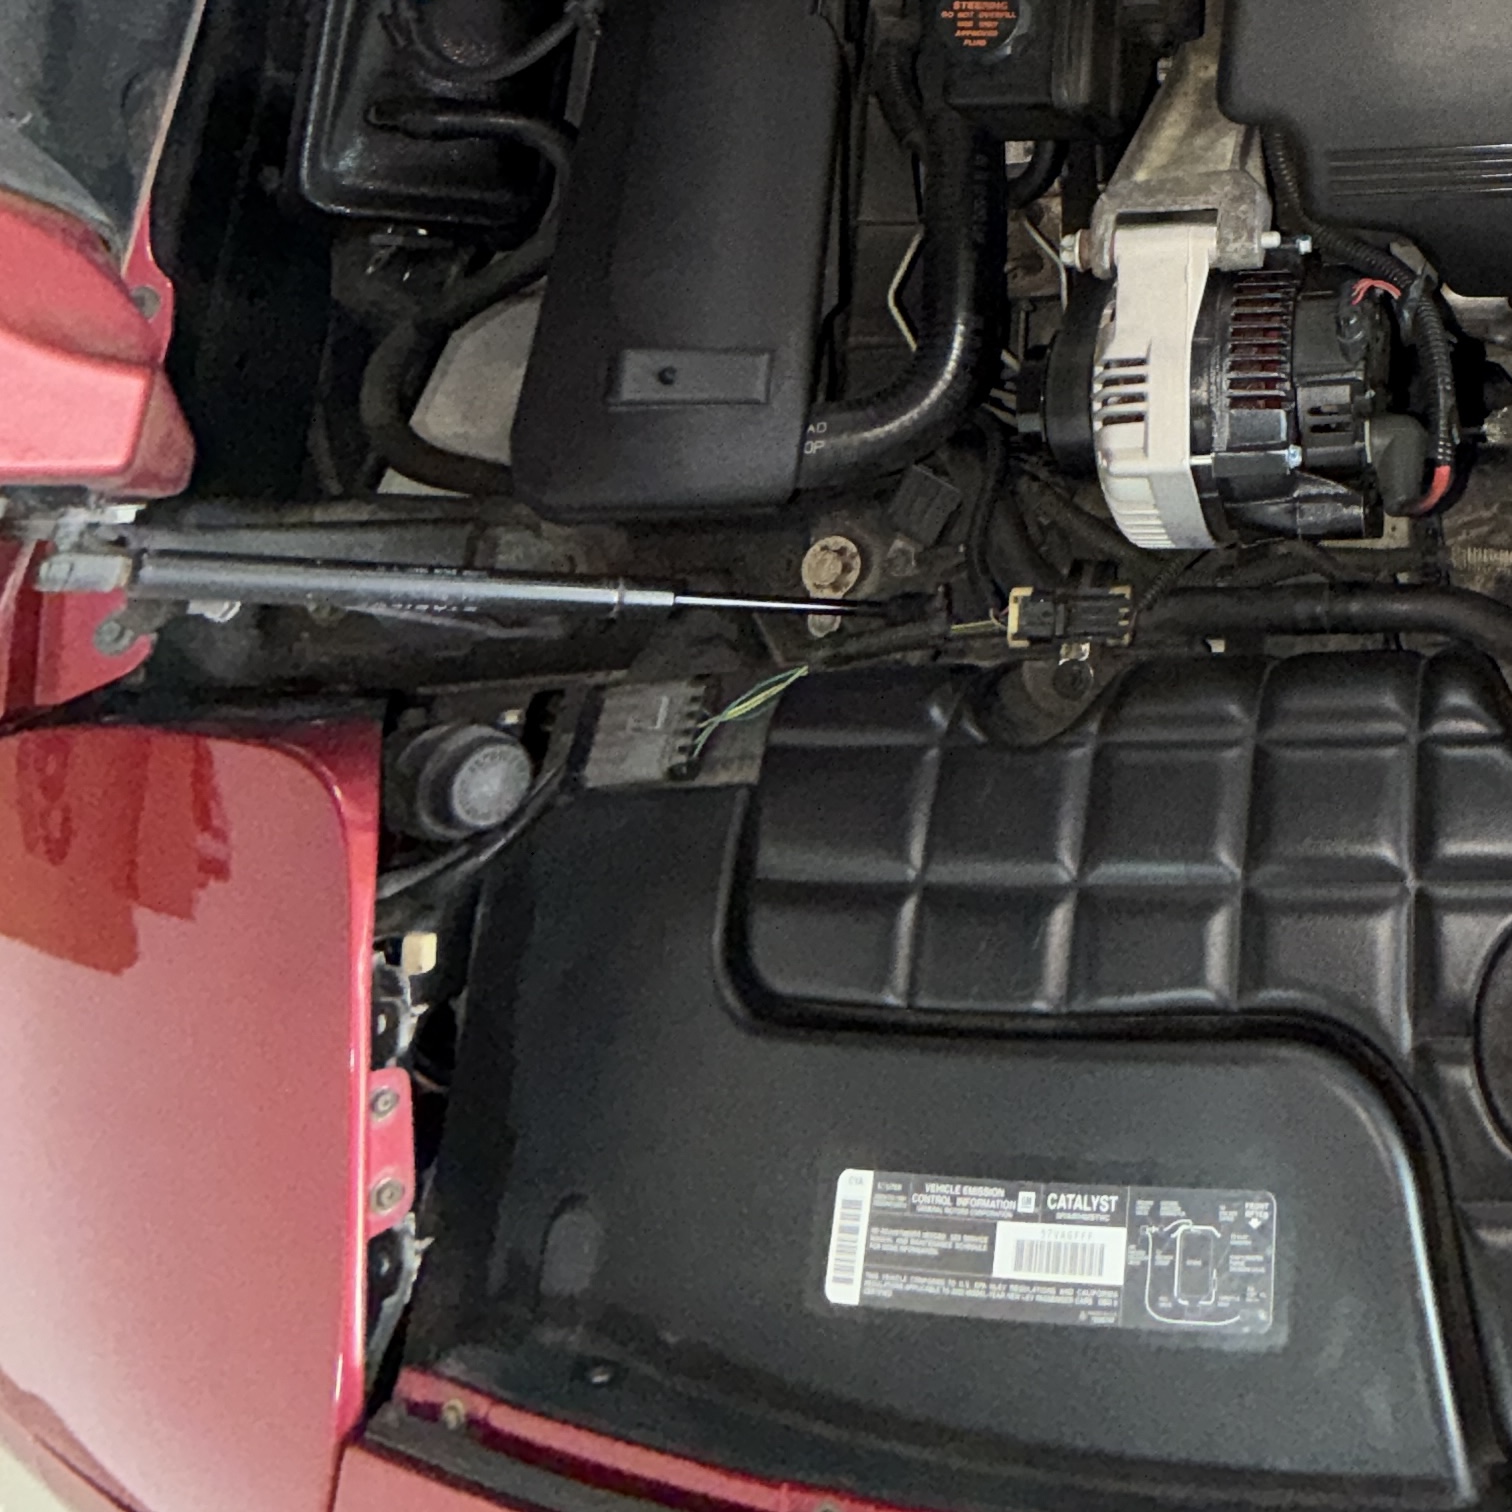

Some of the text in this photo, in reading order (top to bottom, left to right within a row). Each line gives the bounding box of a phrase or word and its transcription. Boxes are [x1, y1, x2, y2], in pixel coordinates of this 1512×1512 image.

[953, 1, 1008, 10] STEERING
[925, 1182, 1006, 1197] VEHICLE EMISSION
[911, 1193, 952, 1206] CONTROL
[956, 1196, 1017, 1209] INFORMATION
[1047, 1193, 1119, 1213] CATALYST
